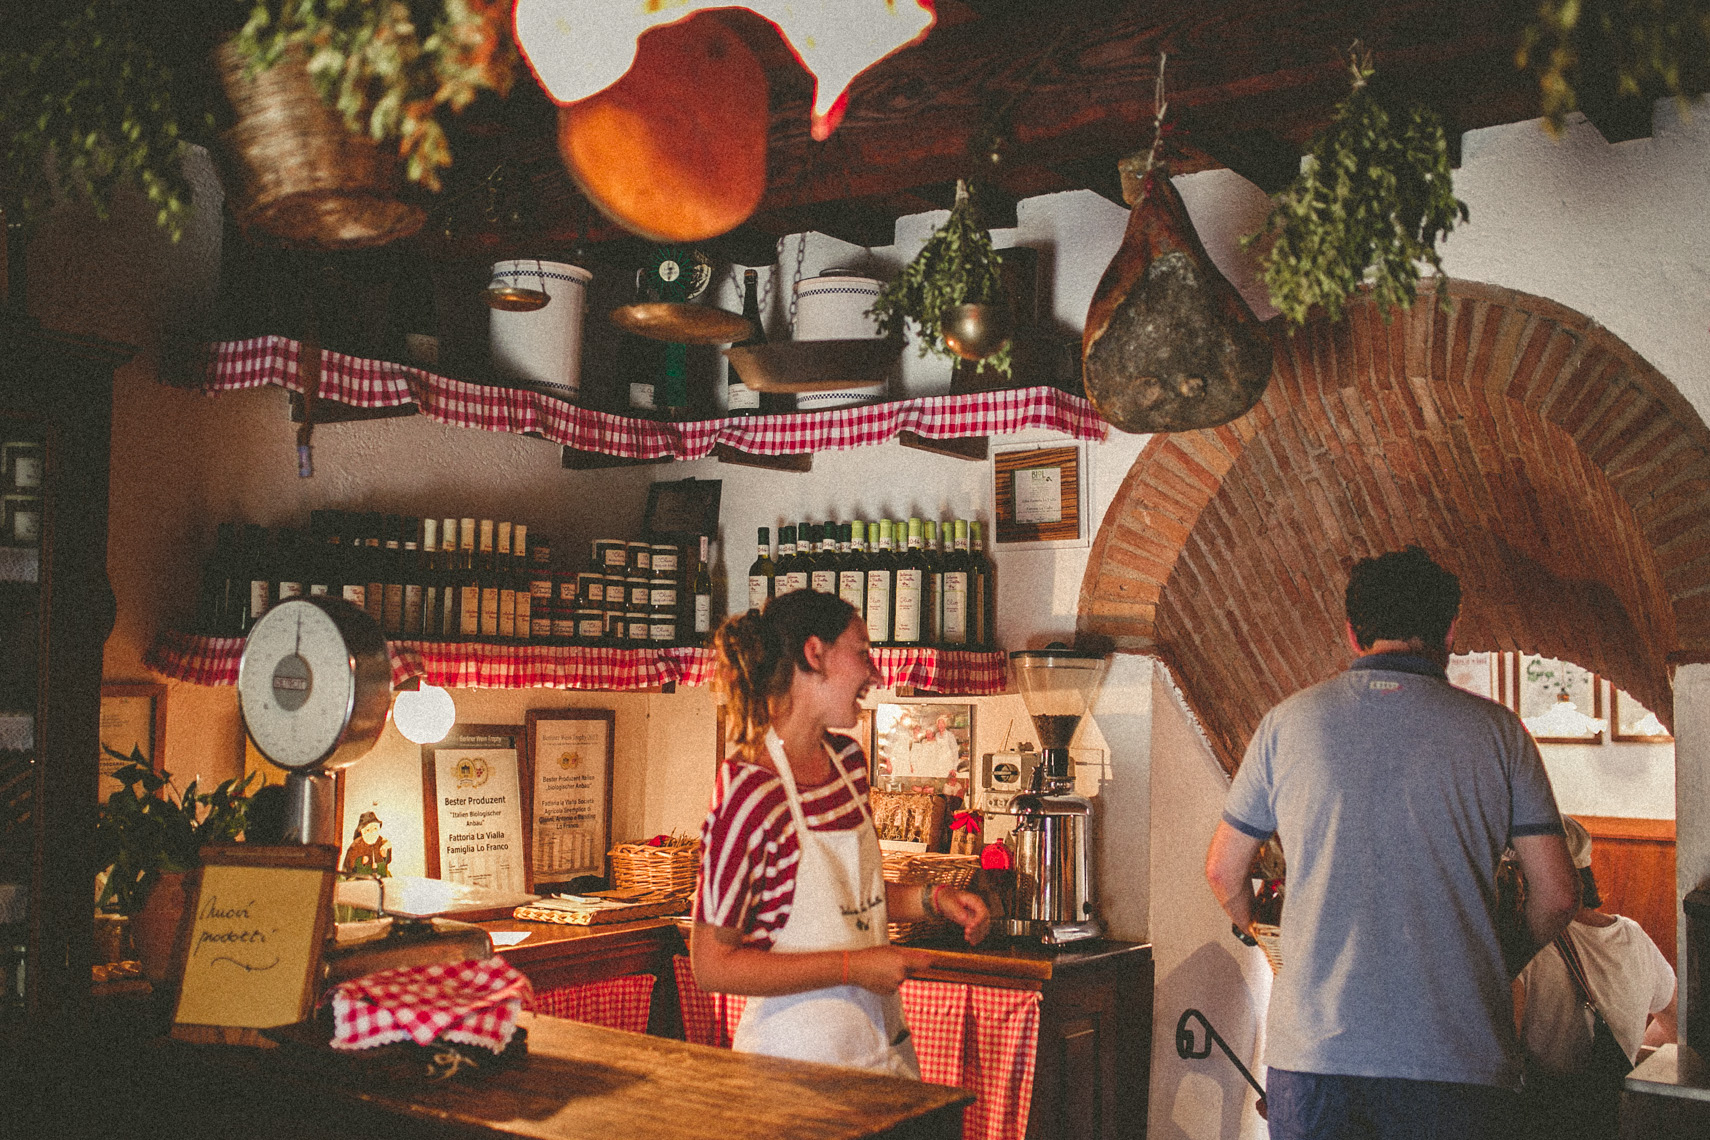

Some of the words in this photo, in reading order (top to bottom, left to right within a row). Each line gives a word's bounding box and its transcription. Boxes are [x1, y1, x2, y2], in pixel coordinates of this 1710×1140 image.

[444, 797, 466, 806] Bester
[468, 795, 506, 805] Produzent
[469, 810, 502, 818] Biologischer
[448, 832, 475, 842] Fattoria
[476, 832, 485, 840] La
[485, 831, 505, 839] Vialla
[446, 845, 475, 855] Famiglia
[476, 844, 485, 852] Lo
[486, 843, 509, 852] Franco
[192, 928, 278, 956] prodotti
